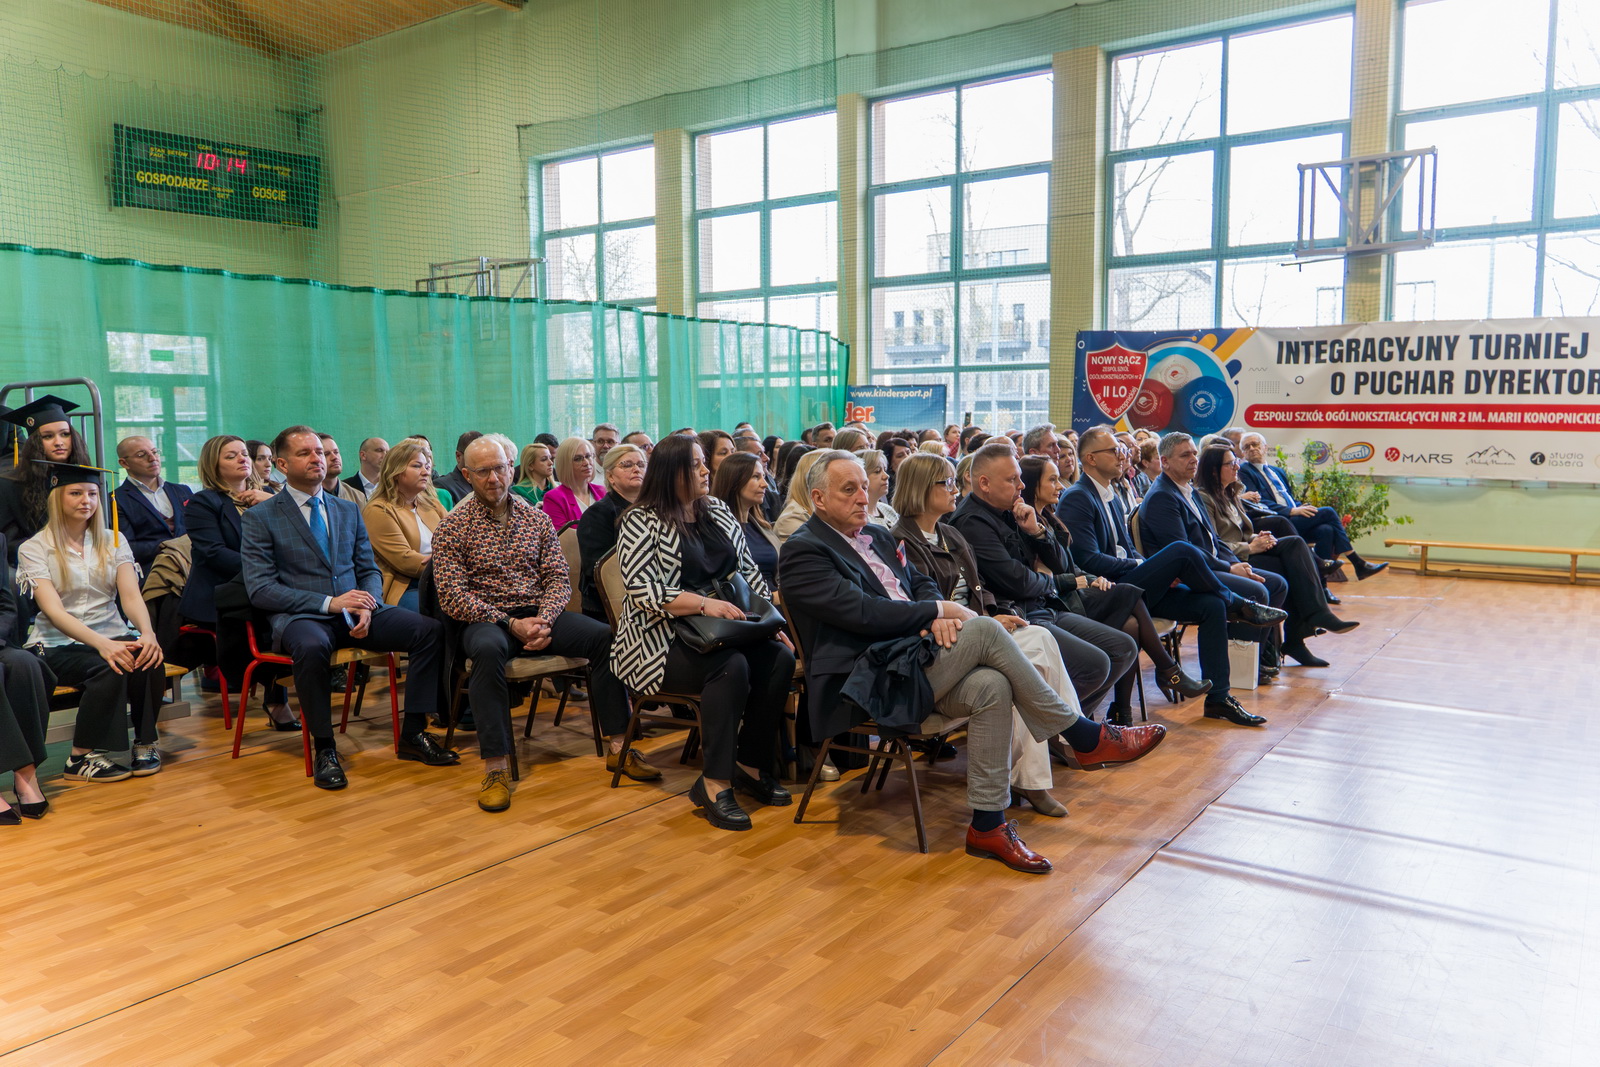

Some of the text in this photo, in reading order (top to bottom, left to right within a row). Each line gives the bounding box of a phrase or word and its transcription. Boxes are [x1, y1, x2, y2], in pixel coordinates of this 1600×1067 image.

[197, 153, 247, 174] 10:14
[136, 170, 209, 191] GOSPODARZE
[1276, 332, 1589, 365] INTEGRACYJNY TURNIEJ
[1091, 356, 1141, 367] NOWY SĄCZ
[1331, 368, 1600, 396] O PUCHAR DYREKTOR
[850, 388, 933, 399] www.kindersport.pl
[1103, 386, 1127, 398] II LO
[1253, 409, 1600, 424] ZESPOŁU SZKÓŁ OGÓLNOKSZTAŁCĄCYCH NR 2 IM. MARII KONOPNICKIE
[1402, 453, 1453, 464] MARS
[1549, 452, 1584, 460] studio
[1548, 459, 1584, 468] lasera
